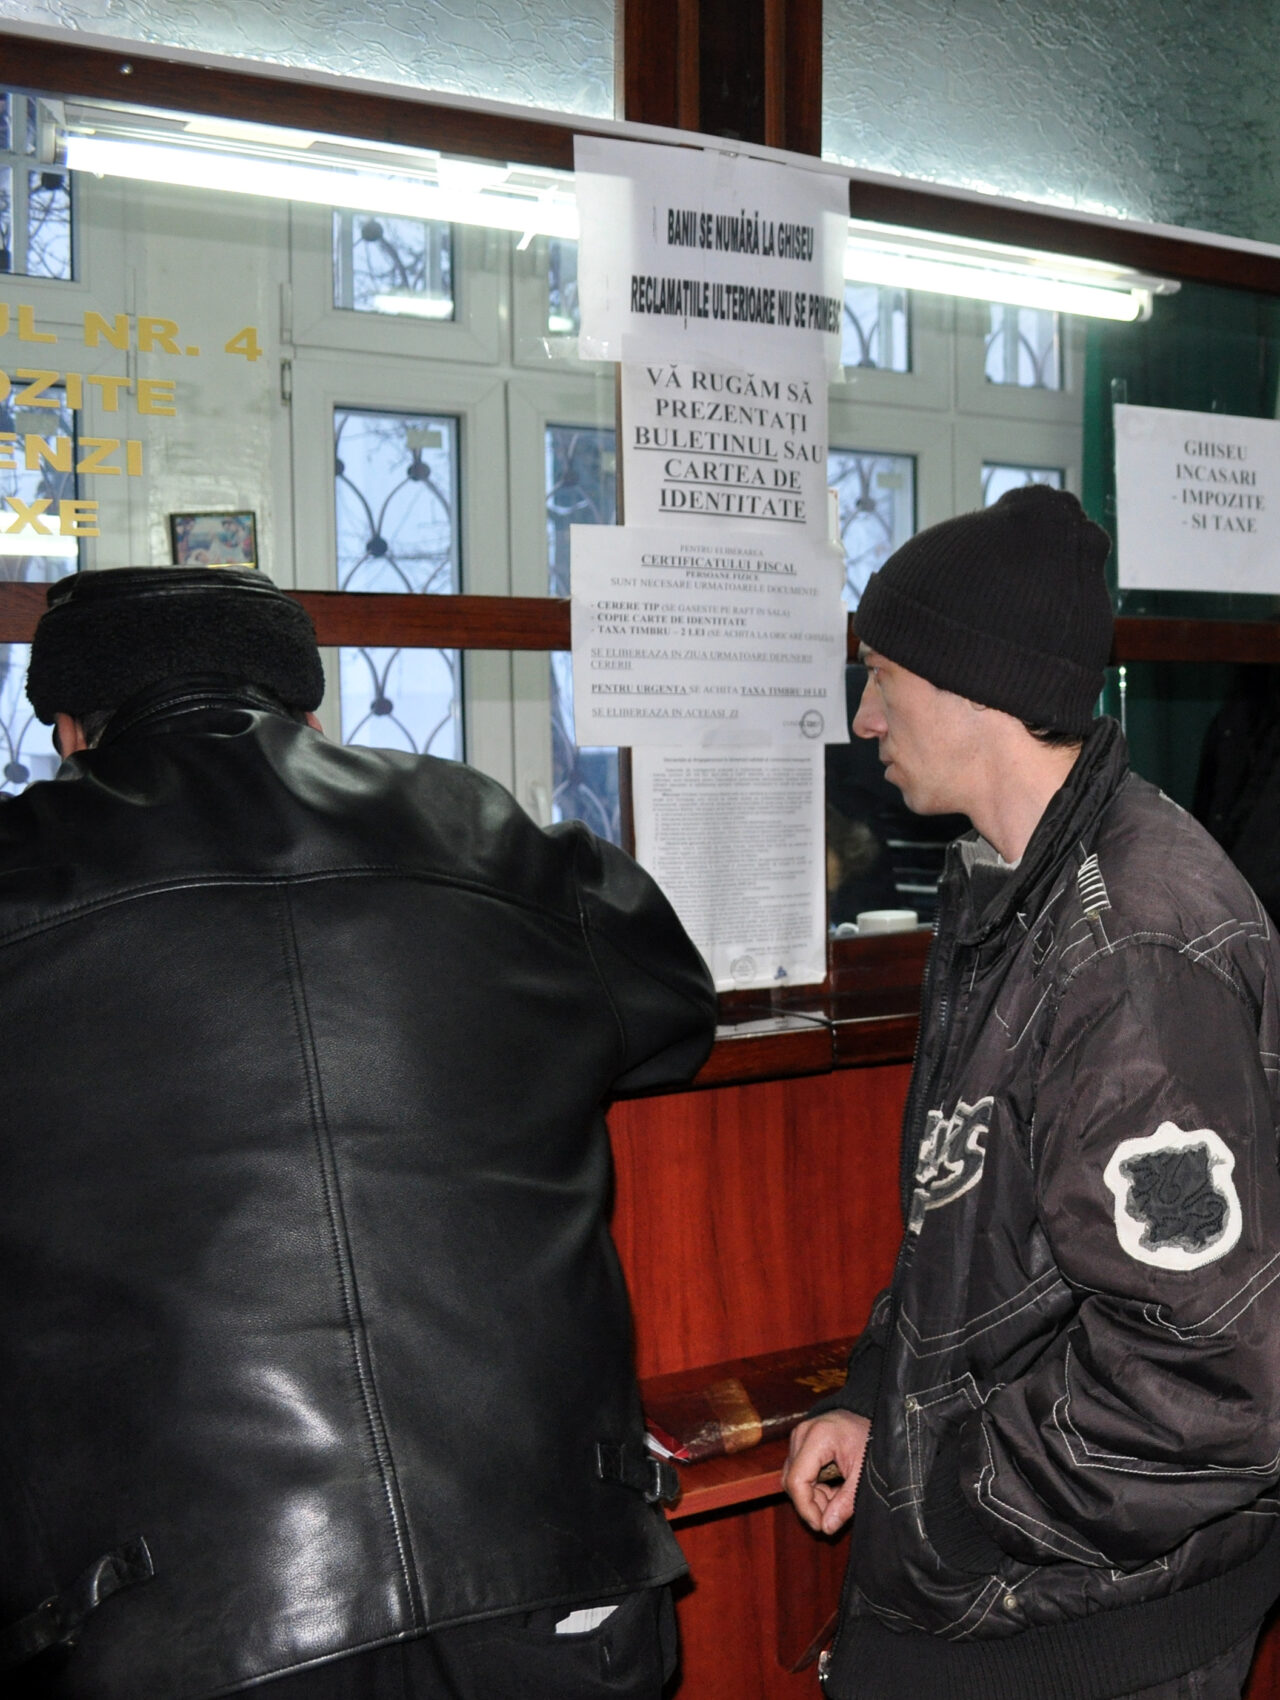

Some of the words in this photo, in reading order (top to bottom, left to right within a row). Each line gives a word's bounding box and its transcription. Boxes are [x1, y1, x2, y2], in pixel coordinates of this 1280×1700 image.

[668, 208, 697, 248] BANII
[699, 212, 713, 250] SE
[762, 219, 775, 257] LA
[778, 221, 814, 263] GHISEU
[712, 283, 775, 326] ULTERIOARE
[778, 290, 792, 328] NU
[795, 291, 806, 328] SE
[84, 311, 200, 357] NR.
[224, 326, 263, 362] 4
[647, 364, 681, 389] VĂ
[692, 370, 780, 400] RUGĂM
[787, 382, 813, 405] SĂ
[656, 398, 807, 436] PREZENTAȚI
[635, 426, 778, 458] BULETINUL
[784, 440, 824, 464] SAU
[1184, 439, 1248, 461] GHISEU
[664, 458, 766, 487] CARTEA
[774, 468, 802, 490] DE
[1176, 463, 1257, 486] INCASARI
[660, 488, 806, 519] IDENTITATE
[1182, 488, 1266, 511] IMPOZITE
[0, 497, 100, 537] XE
[1192, 513, 1207, 530] SI
[1213, 514, 1257, 534] TAXE
[641, 554, 752, 569] CERTIFICATULUI
[756, 560, 797, 574] FISCAL
[610, 577, 637, 588] SUNT
[640, 578, 693, 590] NECESARE
[597, 601, 639, 611] CERERE
[644, 602, 660, 611] TIP
[597, 613, 629, 623] COPIE
[632, 614, 666, 624] CARTE
[670, 615, 682, 625] DE
[686, 616, 746, 627] IDENTITATE
[598, 625, 627, 635] TAXA
[630, 626, 671, 636] TIMBRU
[687, 628, 705, 637] LEI
[592, 683, 631, 694] PENTRU
[741, 686, 766, 696] TAXA
